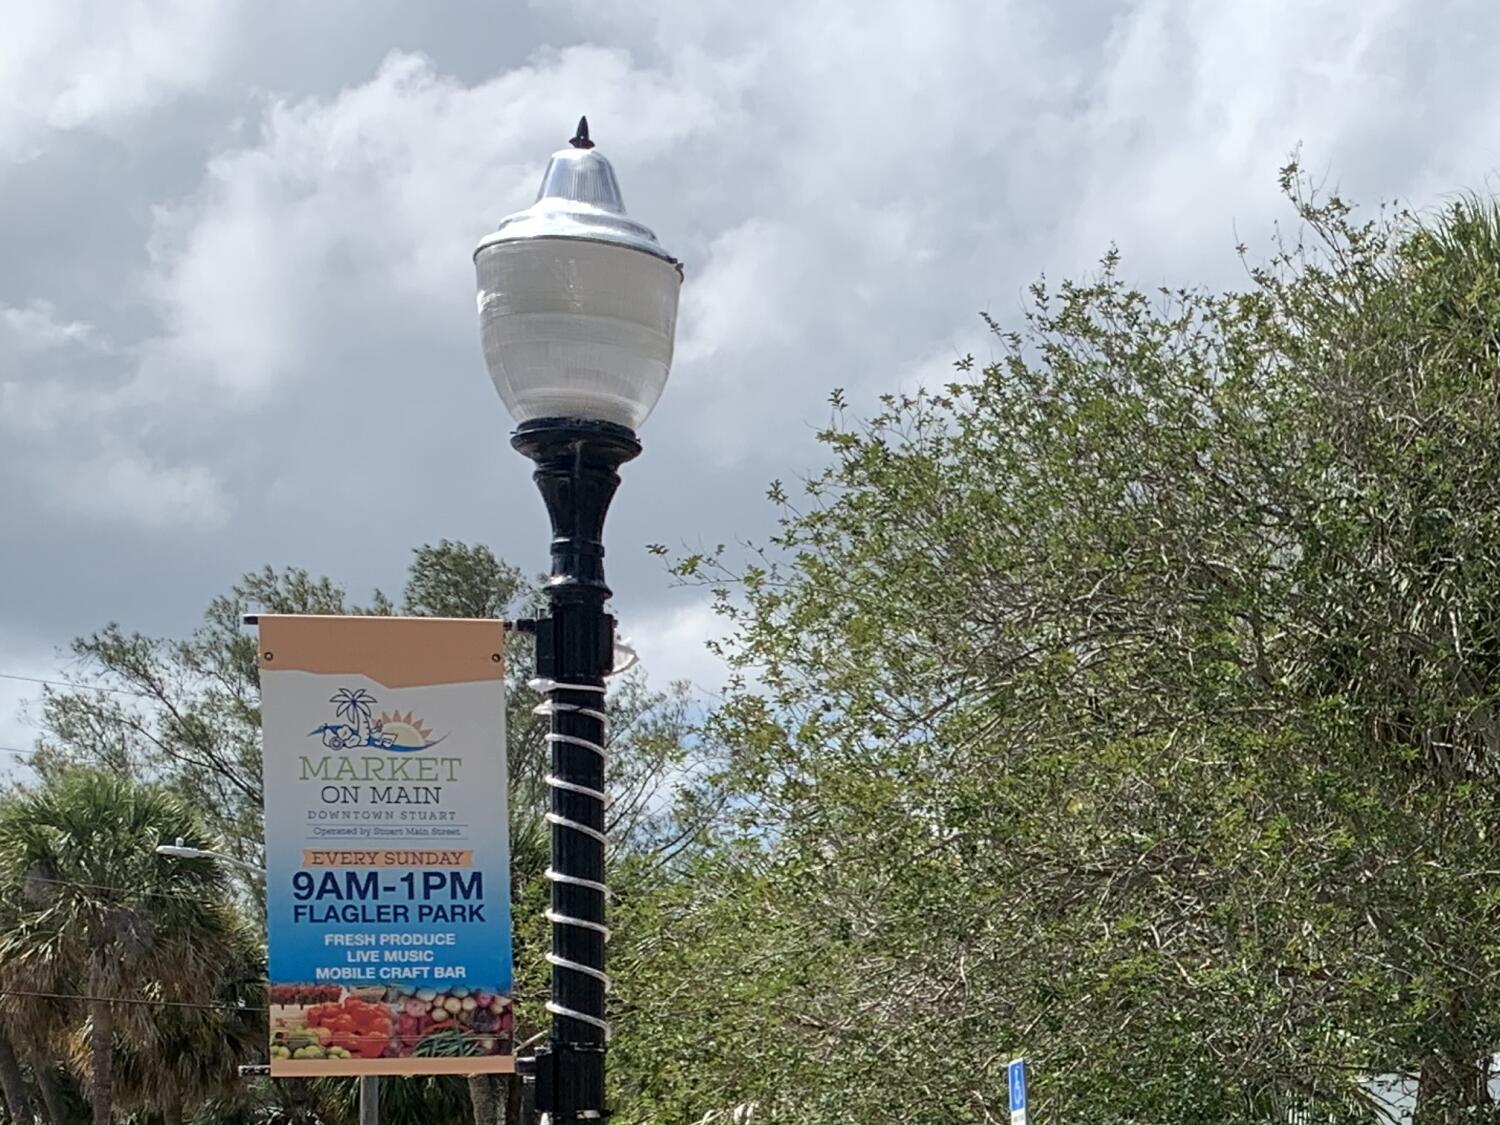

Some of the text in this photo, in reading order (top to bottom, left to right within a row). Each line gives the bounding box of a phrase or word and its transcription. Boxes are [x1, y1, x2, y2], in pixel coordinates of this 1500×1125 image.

[299, 756, 462, 782] MARKET
[321, 786, 442, 804] ON MAIN
[307, 810, 456, 820] DOWNTOWN STUART
[313, 827, 461, 837] Operated by Stuart Main Street
[312, 852, 464, 865] EVERY SUNDAY
[292, 871, 483, 901] 9AM-1PM
[294, 904, 486, 923] FLAGLER PARK
[325, 934, 456, 946] FRESH PRODUCE
[347, 950, 434, 962] LIVE MUSIC
[316, 967, 466, 980] MOBILE CRAFT BAR
